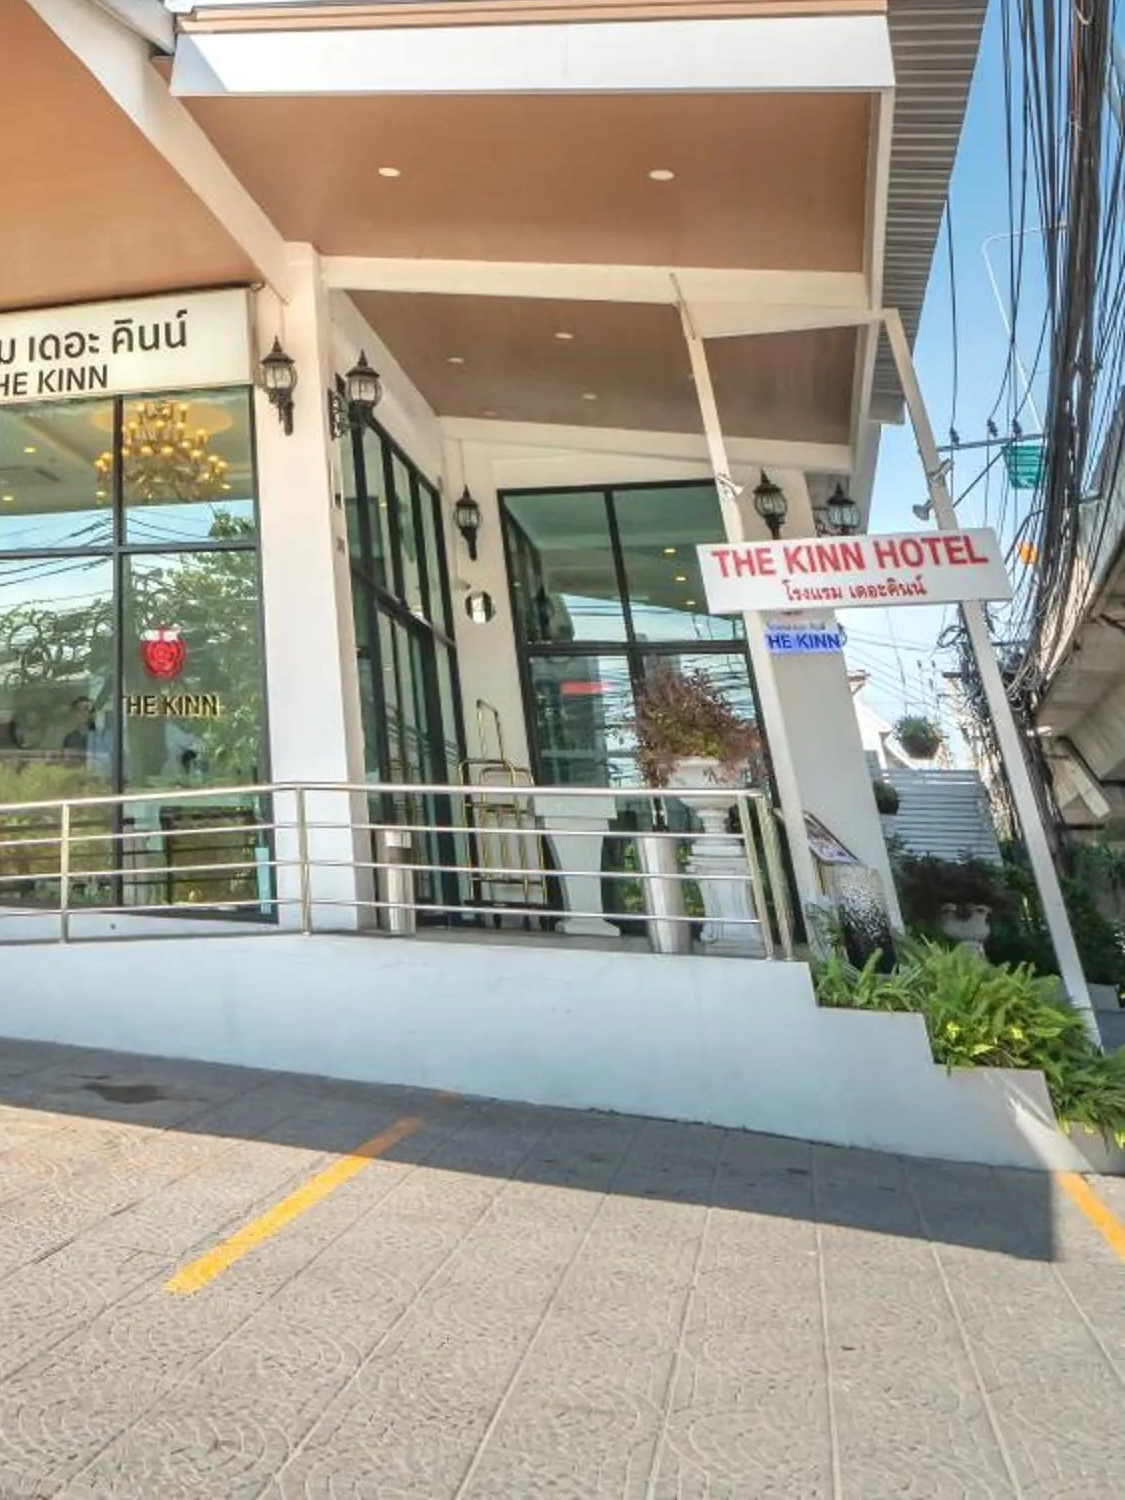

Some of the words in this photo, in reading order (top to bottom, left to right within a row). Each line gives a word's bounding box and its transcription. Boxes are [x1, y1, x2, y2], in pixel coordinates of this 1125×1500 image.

[29, 331, 100, 362] เดอะ
[112, 309, 188, 354] คินน์
[38, 364, 108, 394] KINN
[711, 547, 776, 578] THE
[784, 541, 866, 574] KINN
[873, 535, 988, 569] HOTEL
[782, 579, 842, 601] โรงแรม
[765, 632, 793, 649] HE
[796, 631, 841, 649] KINN
[165, 692, 220, 717] KINN
